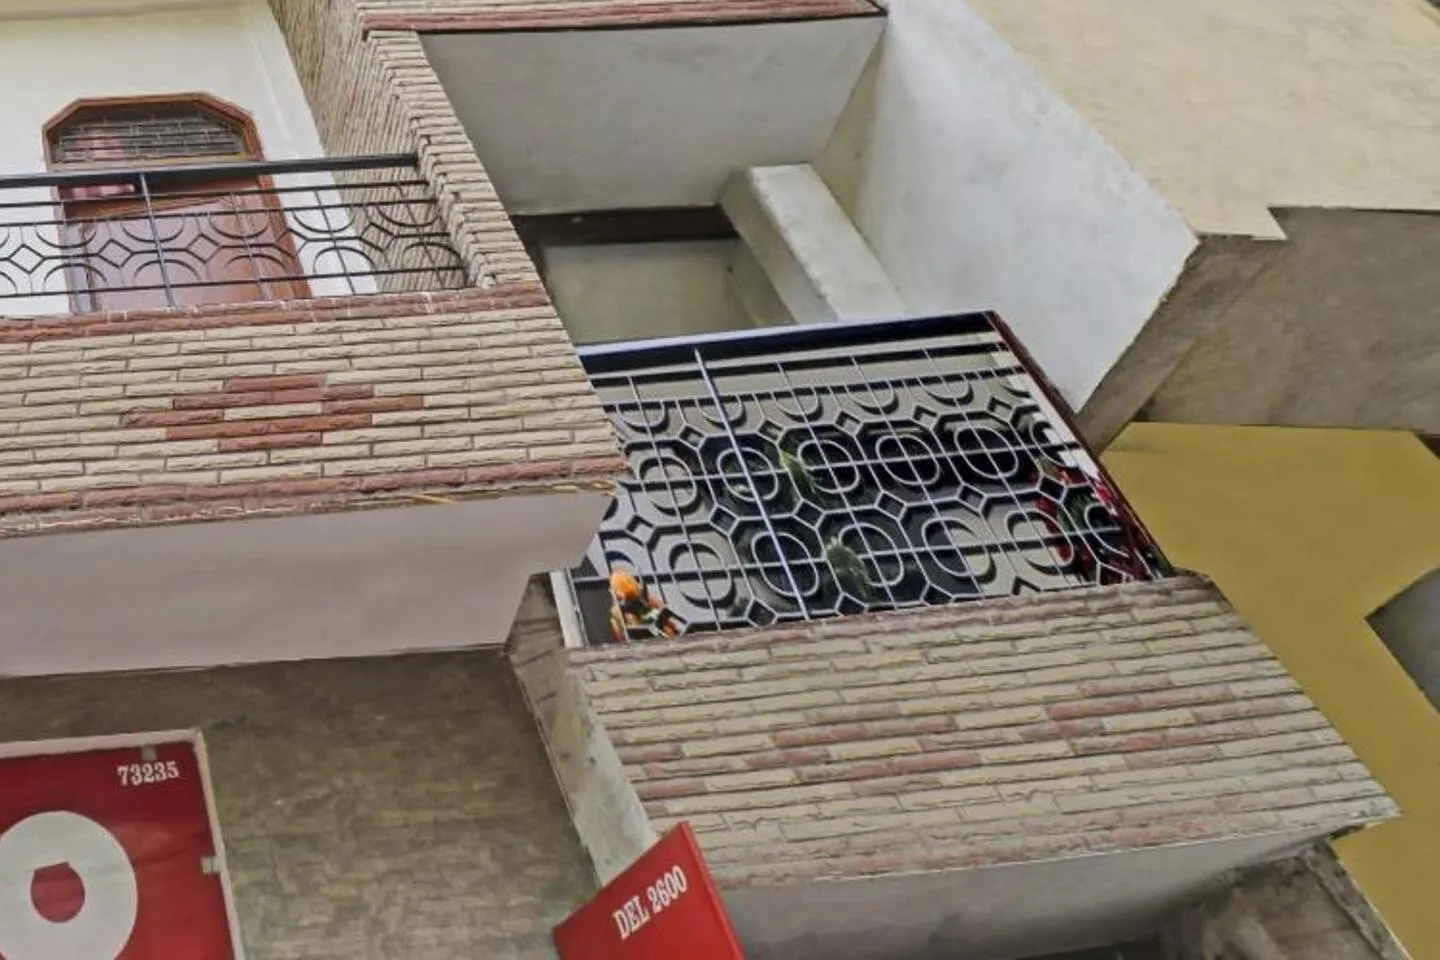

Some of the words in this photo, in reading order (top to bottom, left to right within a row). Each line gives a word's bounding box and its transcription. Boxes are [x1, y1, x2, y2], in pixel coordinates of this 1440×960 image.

[116, 760, 181, 786] 73235
[612, 895, 651, 941] DEL
[647, 864, 689, 915] 2600
